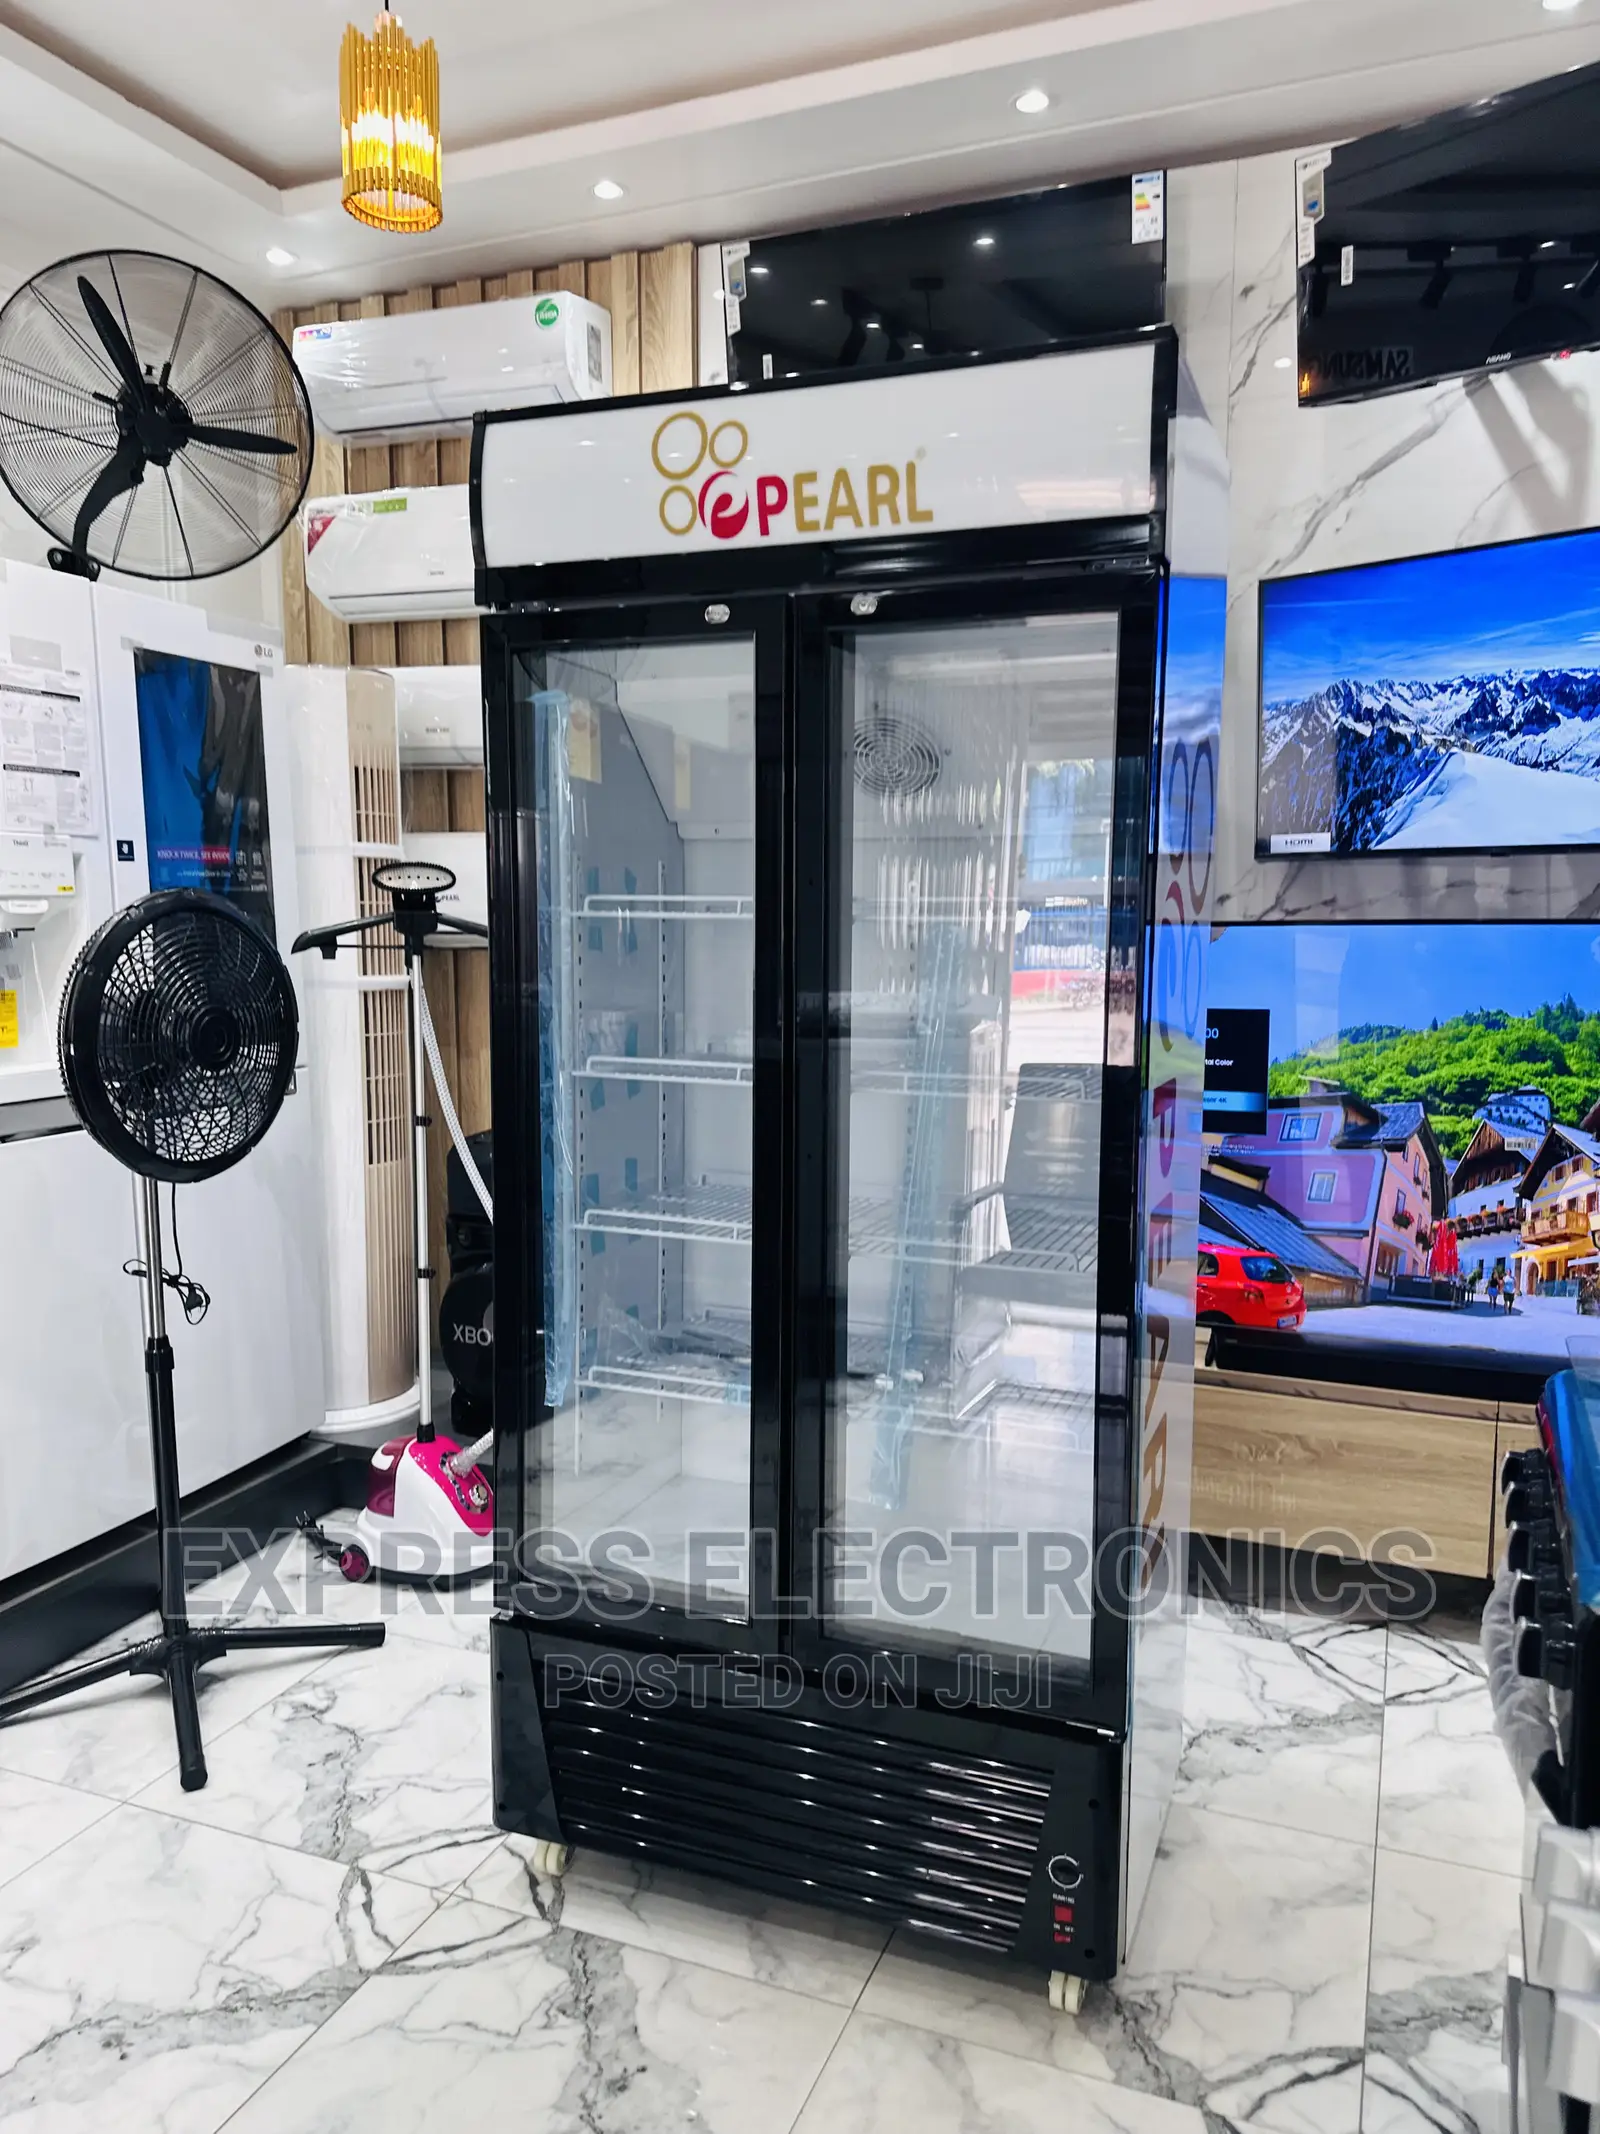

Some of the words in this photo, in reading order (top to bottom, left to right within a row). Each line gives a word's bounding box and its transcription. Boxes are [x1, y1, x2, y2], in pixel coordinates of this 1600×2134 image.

[756, 460, 934, 536] PEARL
[1214, 1058, 1234, 1067] Color
[452, 1323, 494, 1346] XBO
